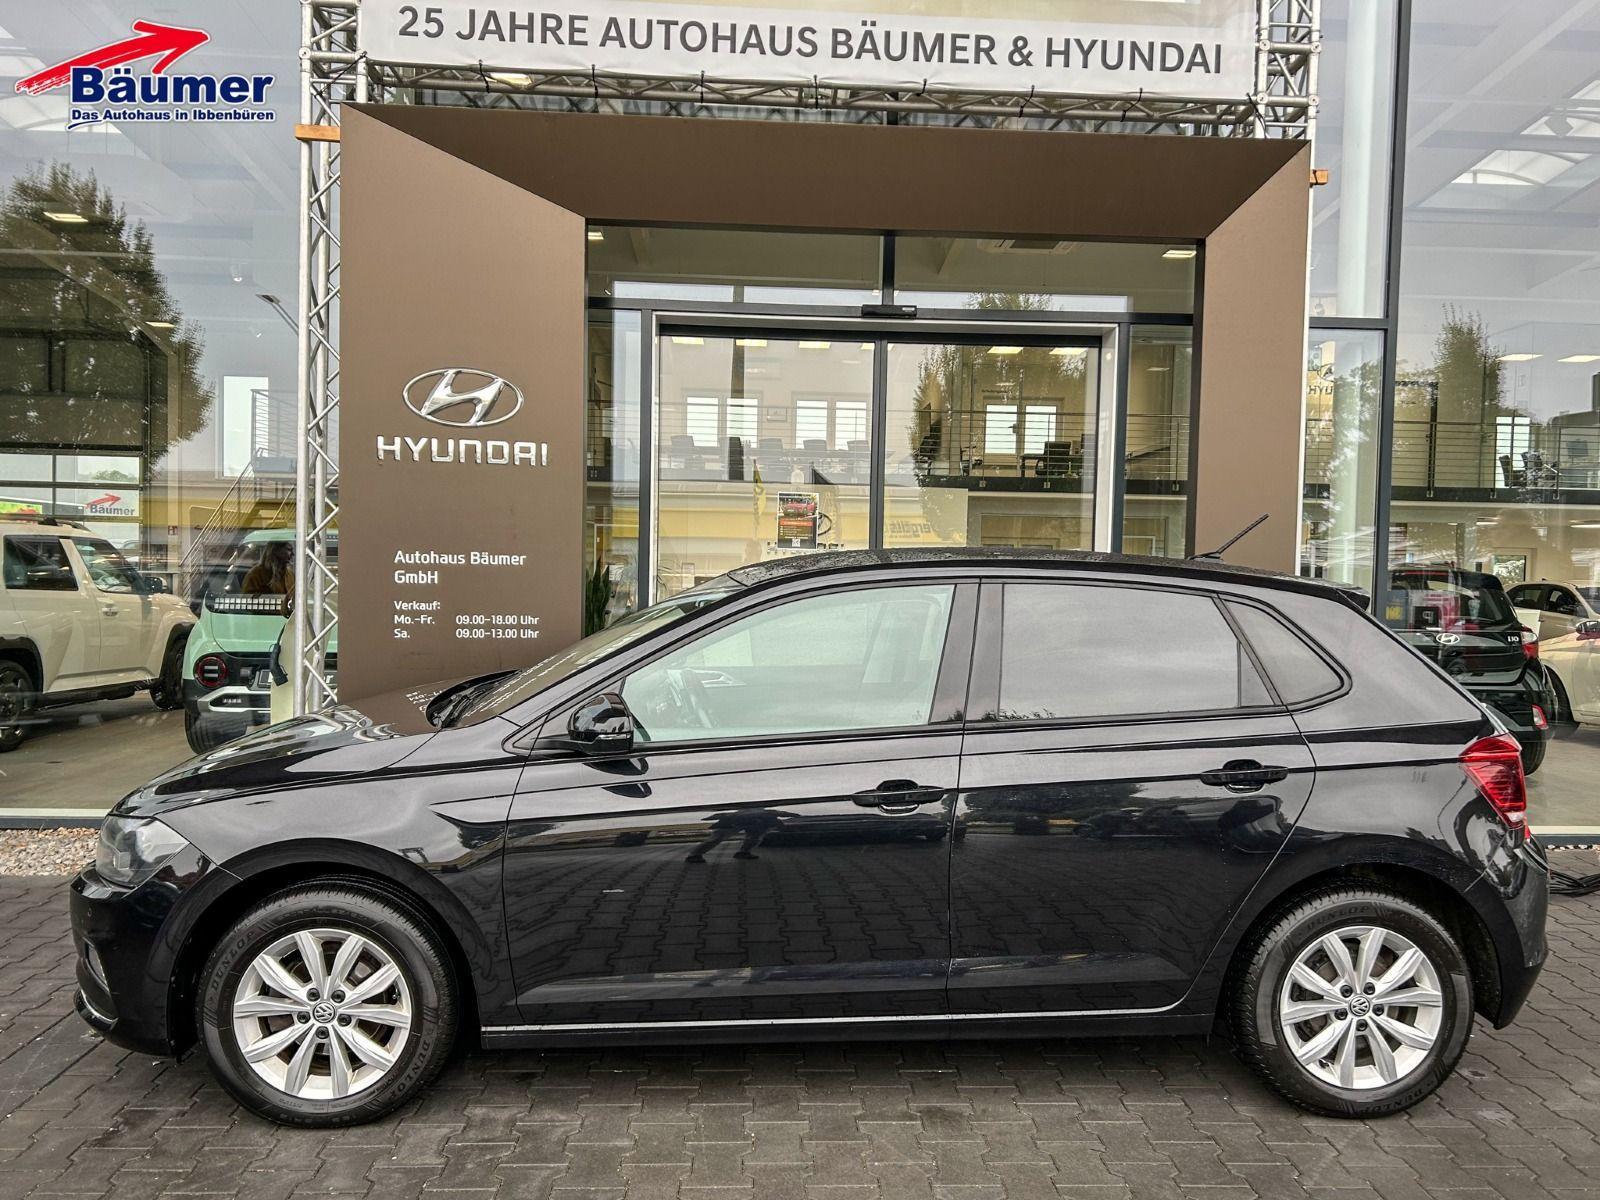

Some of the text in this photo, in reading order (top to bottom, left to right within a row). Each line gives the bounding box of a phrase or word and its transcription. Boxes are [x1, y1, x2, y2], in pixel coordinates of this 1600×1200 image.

[398, 5, 1222, 74] 25 JAHRE AUTOHAUS BÄUMER & HYUNDAI
[376, 435, 548, 466] HYUNDAI
[394, 550, 527, 566] Autohaus Bäumer
[394, 569, 439, 584] GmbH
[394, 600, 441, 611] Verkauf:
[394, 614, 540, 625] Mo.-Fr. 09.00-18.00 Uhr
[394, 628, 540, 639] Sa. 09.00-13.00 Uhr
[1307, 905, 1369, 929] DUNLOP
[211, 931, 256, 991] DUNLOP
[388, 1040, 432, 1098] DUNLOP
